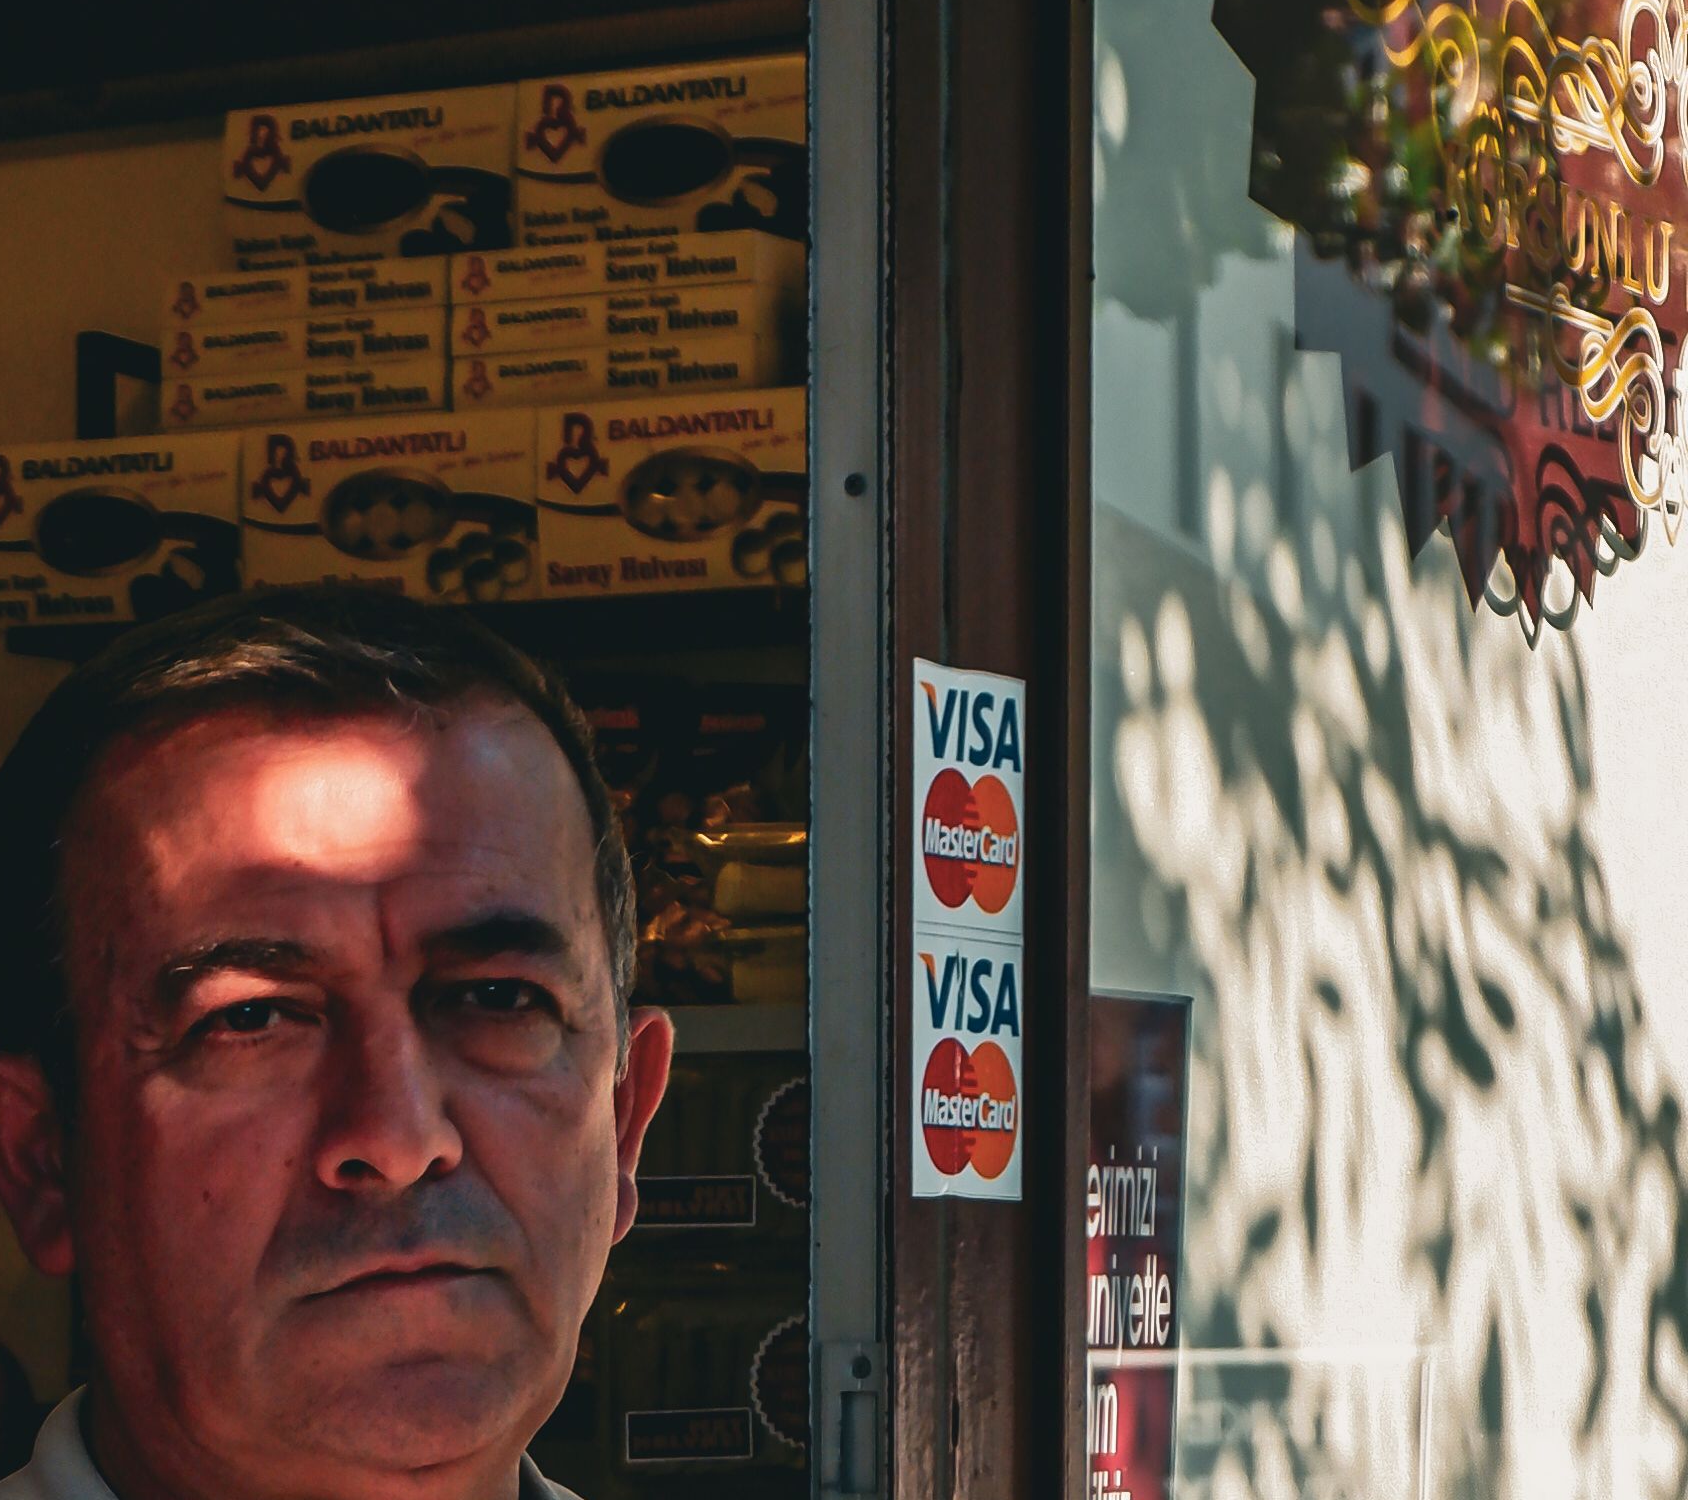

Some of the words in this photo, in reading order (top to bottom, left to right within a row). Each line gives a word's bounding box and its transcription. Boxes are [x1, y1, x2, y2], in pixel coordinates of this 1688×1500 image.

[920, 681, 1021, 773] VISA
[924, 810, 1016, 867] MasterCard
[919, 952, 1020, 1038] VISA
[923, 1079, 1015, 1132] MasterCard
